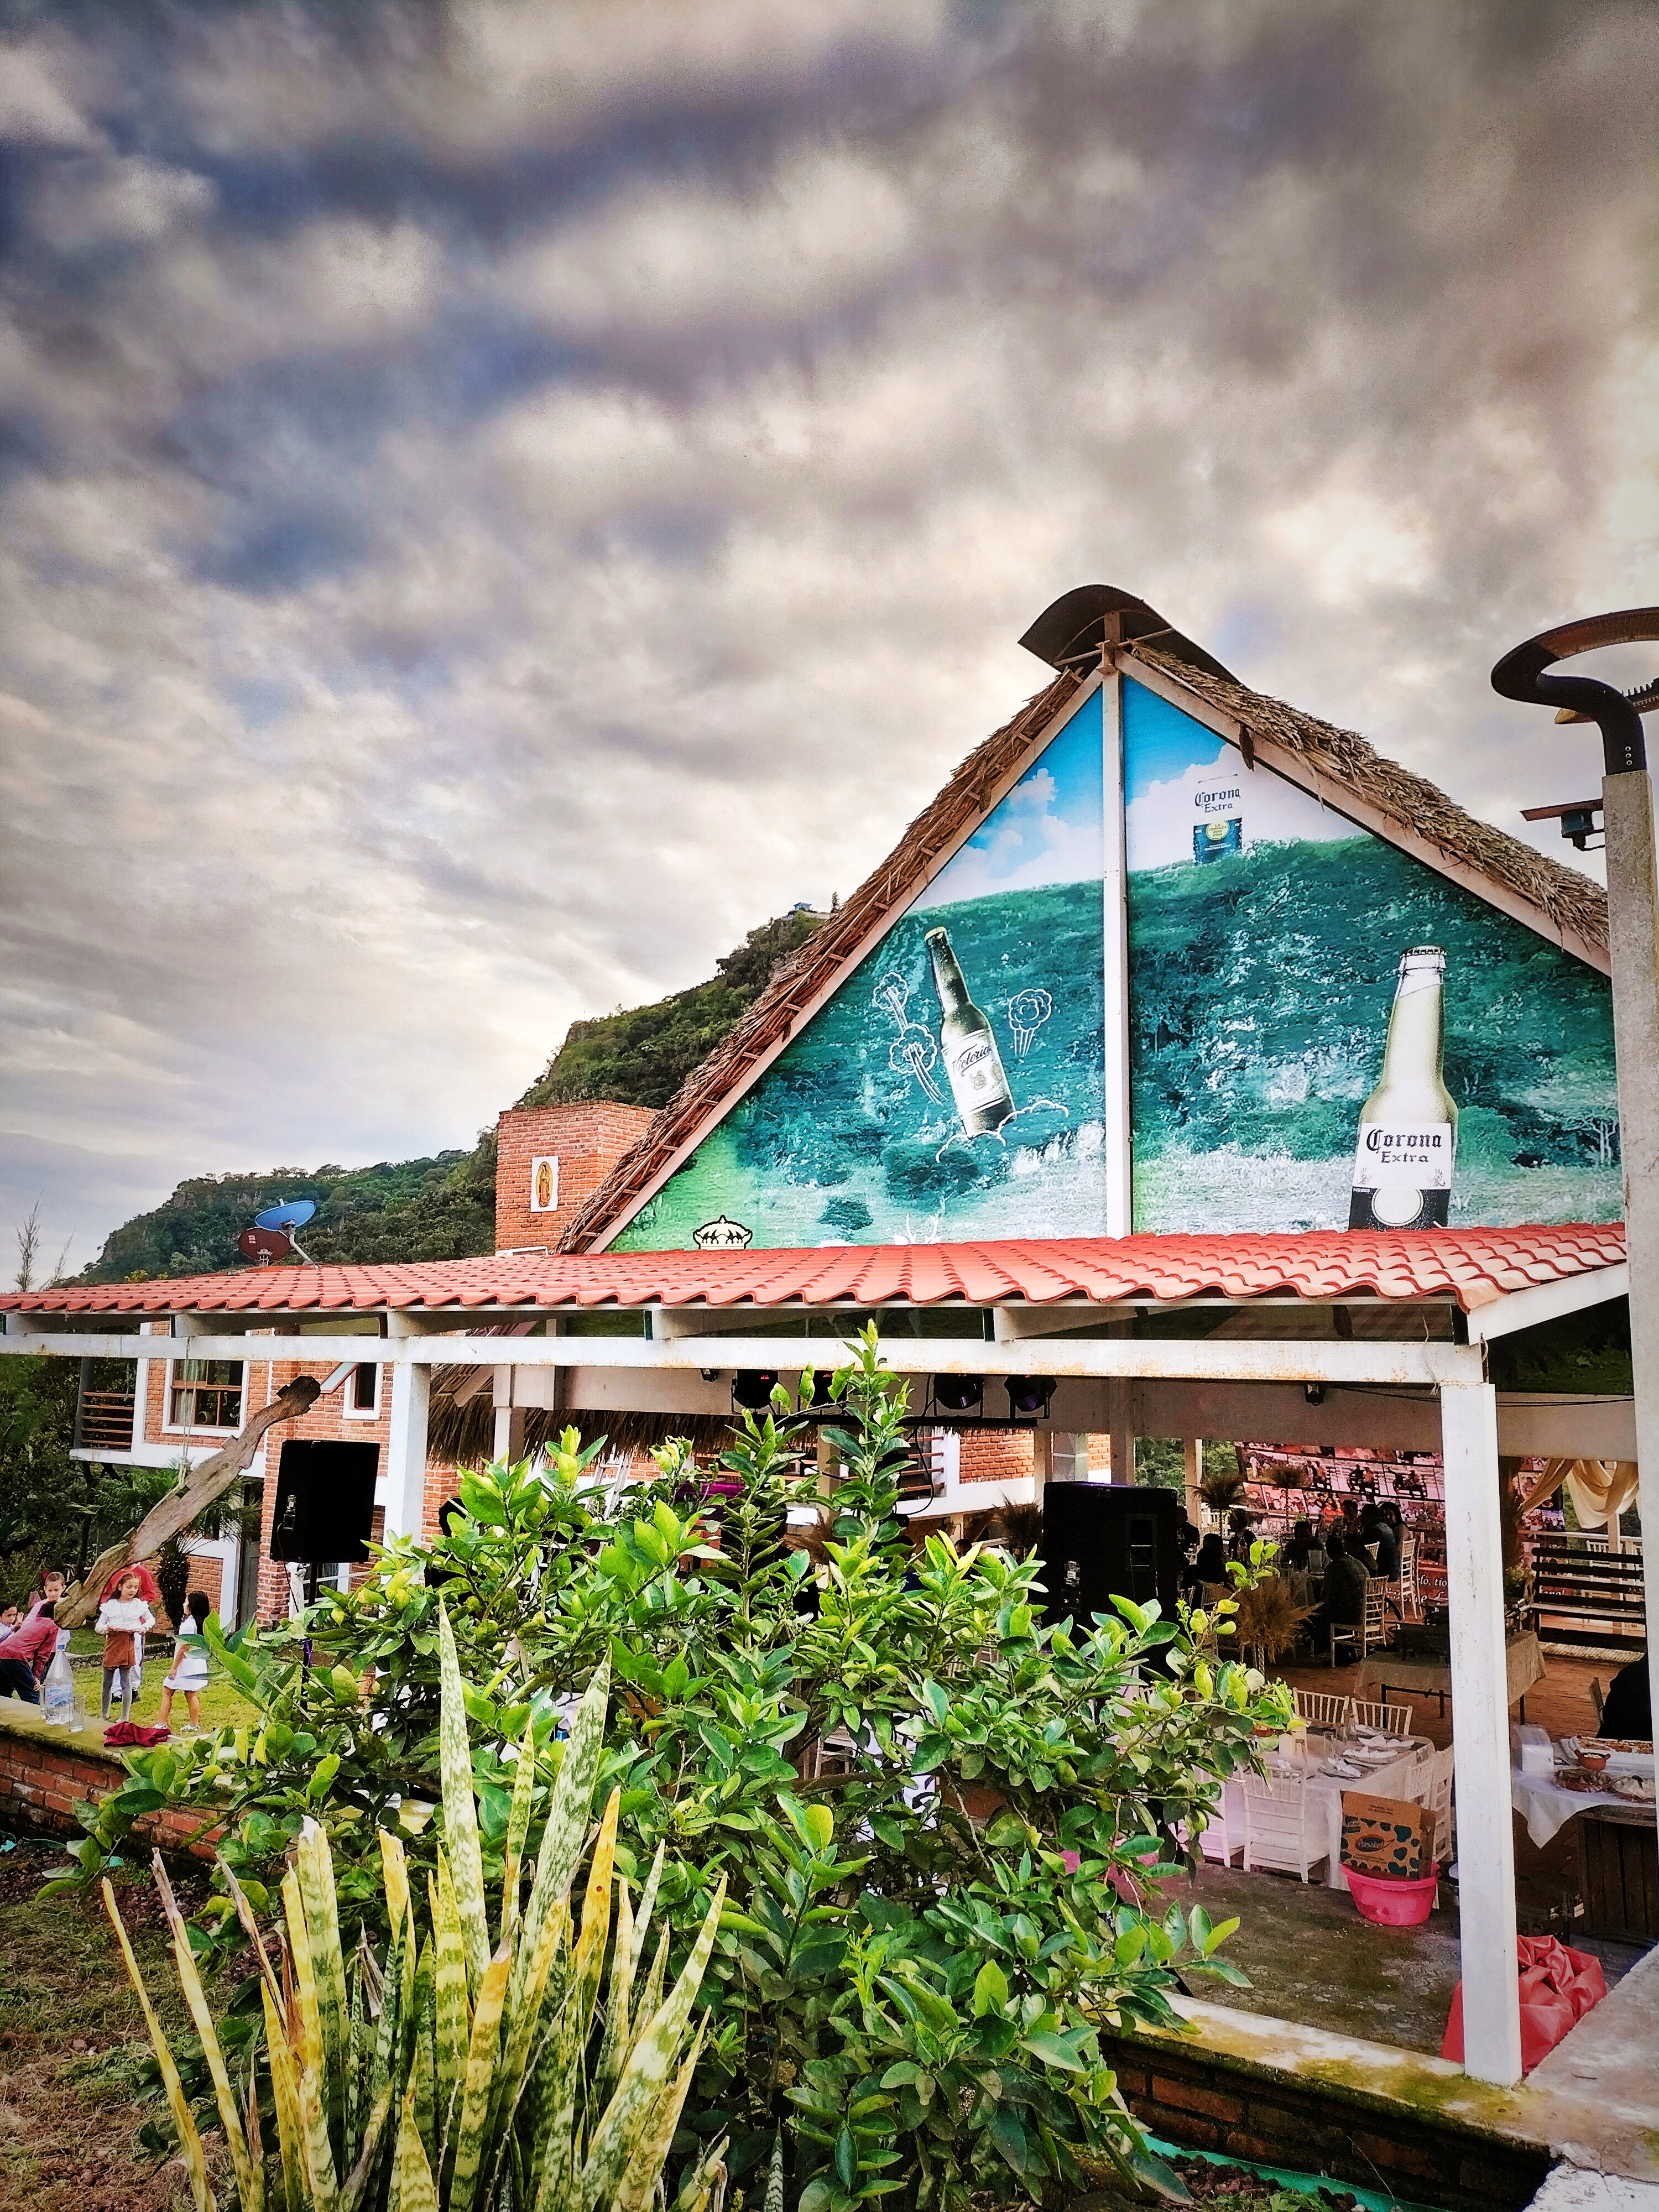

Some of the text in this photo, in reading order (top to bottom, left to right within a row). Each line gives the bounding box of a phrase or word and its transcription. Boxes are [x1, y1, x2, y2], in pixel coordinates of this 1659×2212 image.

[1194, 789, 1241, 808] Corona
[1204, 803, 1233, 813] Extra
[952, 1044, 992, 1077] Victoria
[1366, 1129, 1442, 1154] Corona
[1381, 1151, 1429, 1164] Extra
